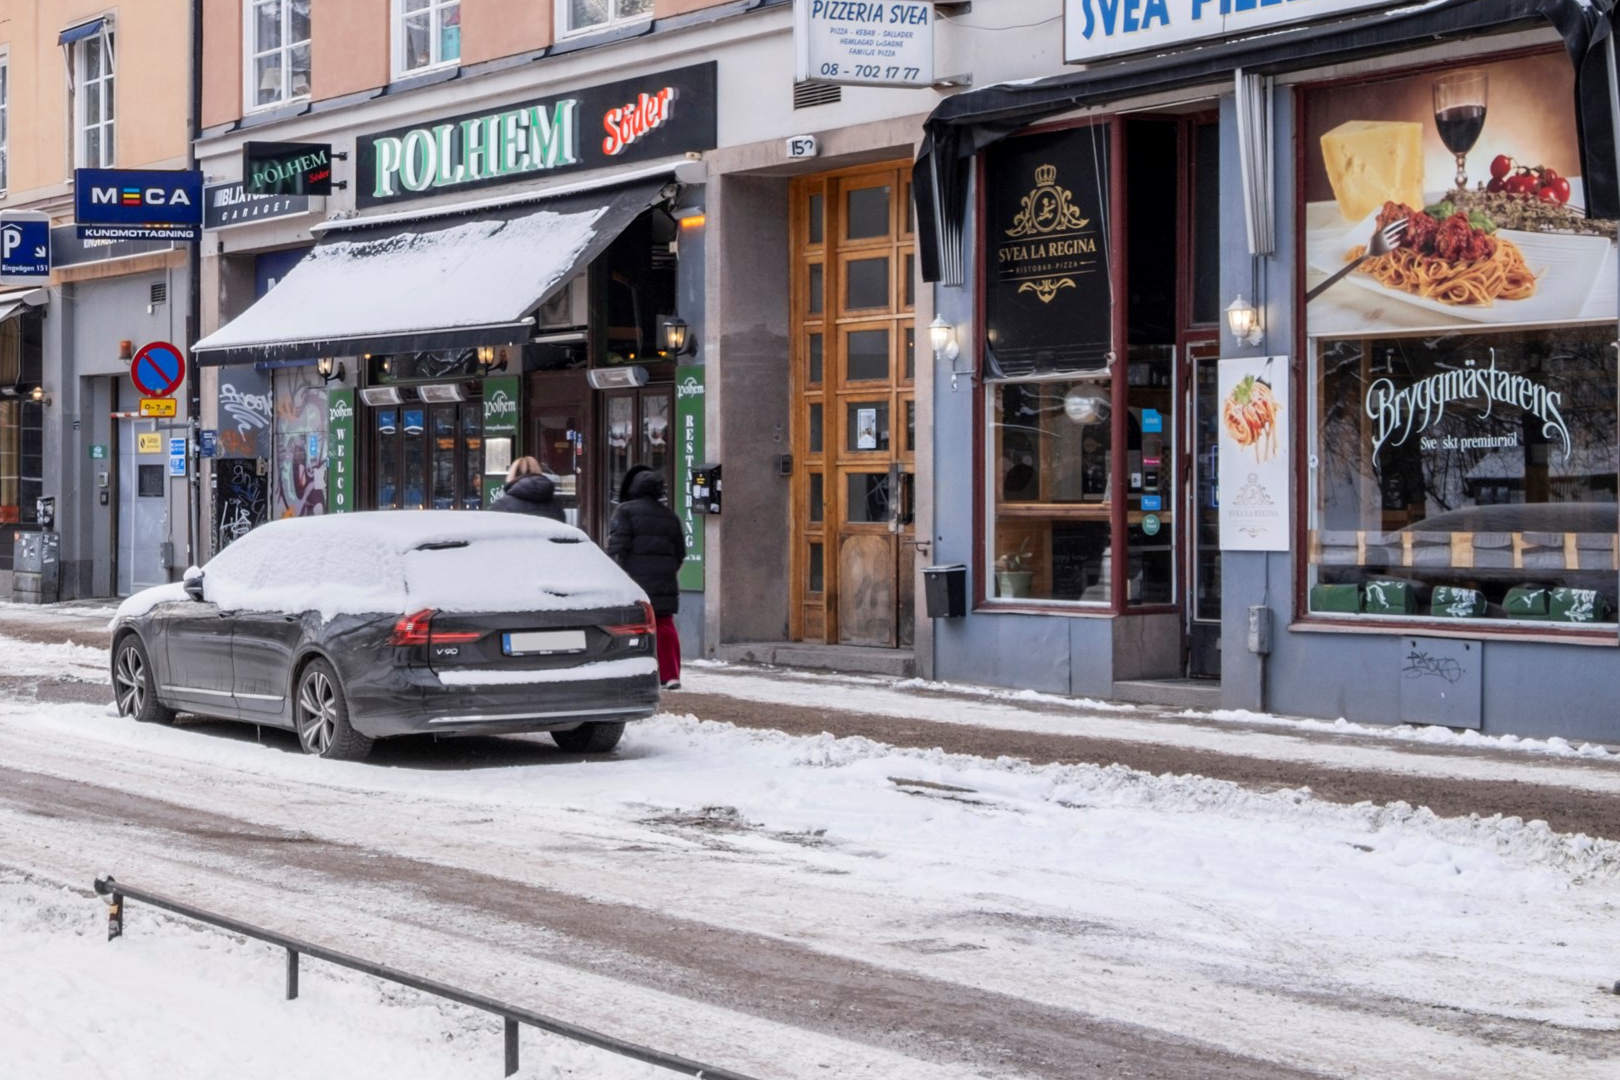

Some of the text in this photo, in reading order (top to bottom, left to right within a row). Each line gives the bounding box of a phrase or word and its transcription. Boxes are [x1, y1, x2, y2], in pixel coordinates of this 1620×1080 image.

[812, 0, 927, 25] PIZZERIA SVEA
[830, 27, 848, 35] PIZZA
[883, 30, 913, 38] SALLADER
[877, 49, 896, 57] PIZZA
[821, 63, 838, 76] 08
[855, 65, 880, 78] 702
[886, 66, 899, 79] 17
[904, 67, 920, 80] 77
[373, 87, 674, 198] POLHEM Söder
[253, 150, 328, 188] POLHEM
[92, 187, 191, 206] MECA
[222, 200, 290, 221] GARAGET
[3, 229, 21, 259] P
[85, 229, 194, 238] KUNDMOTTAGNING
[999, 239, 1096, 262] SVEA LA REGINA
[1365, 347, 1571, 468] Bryggmästarens
[336, 428, 346, 514] WELCO
[490, 485, 505, 504] Söd
